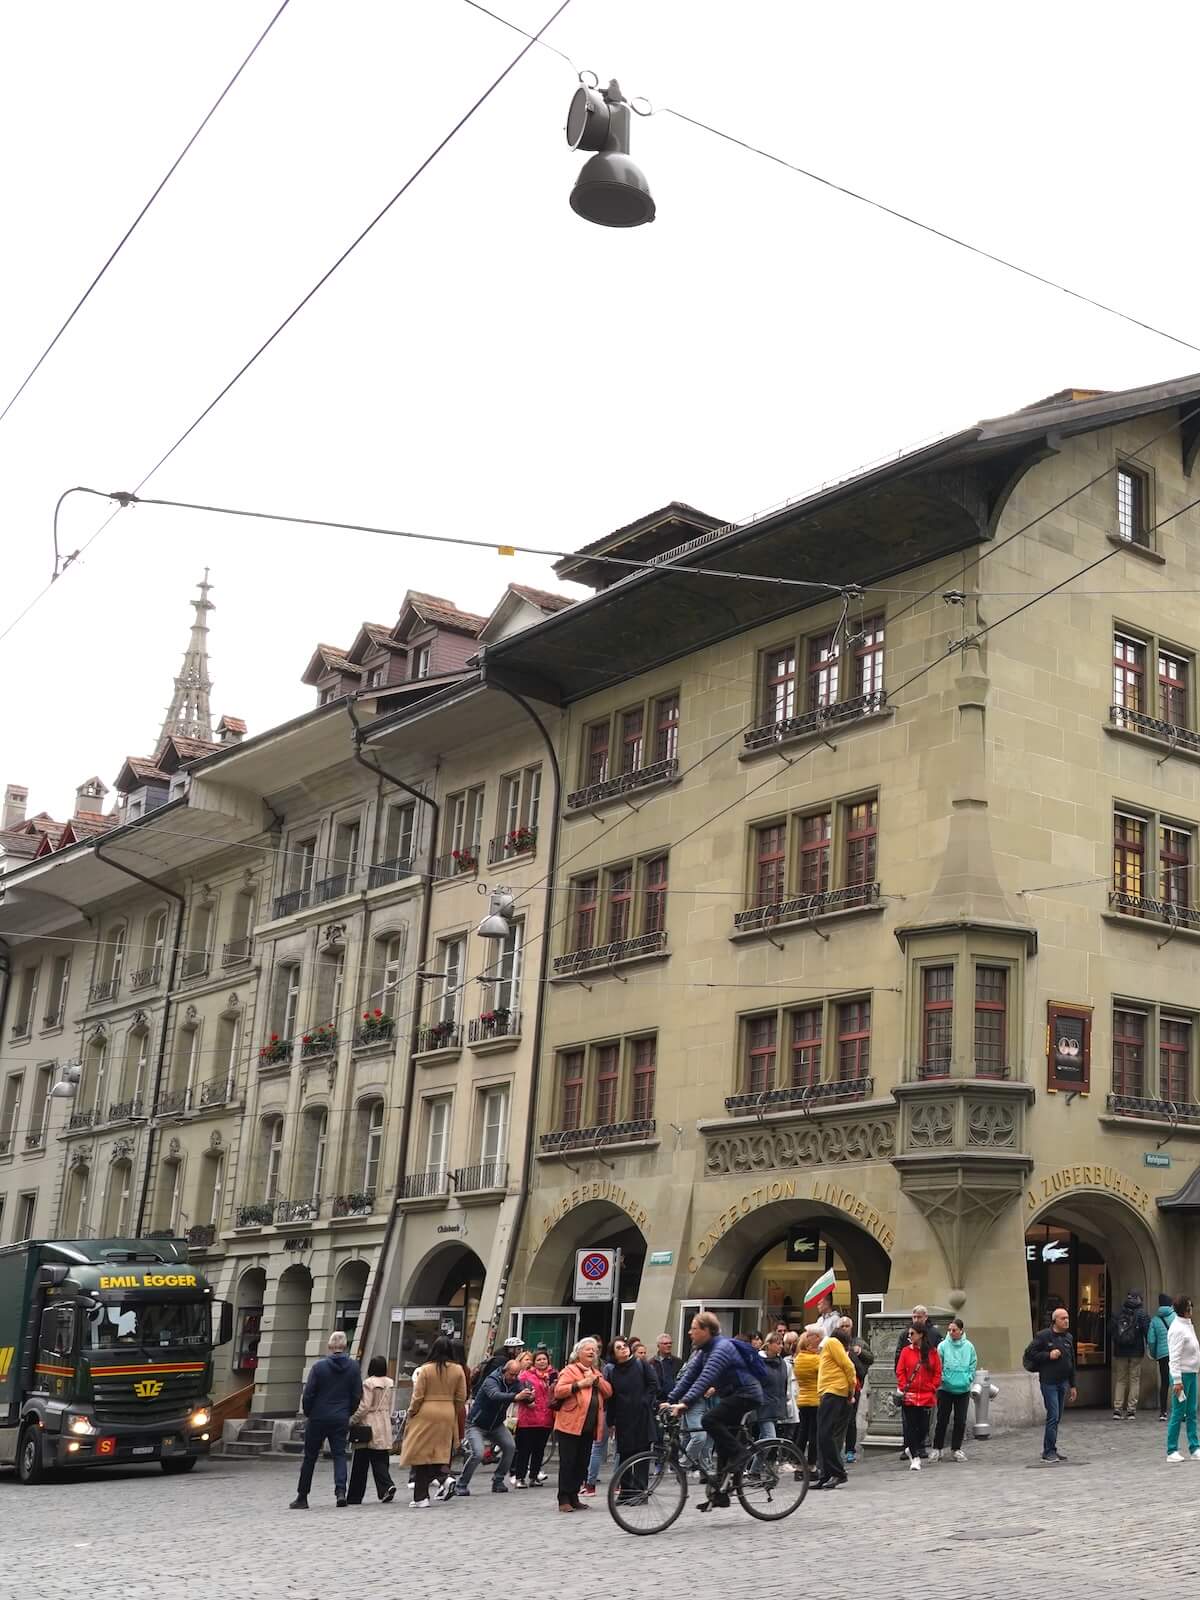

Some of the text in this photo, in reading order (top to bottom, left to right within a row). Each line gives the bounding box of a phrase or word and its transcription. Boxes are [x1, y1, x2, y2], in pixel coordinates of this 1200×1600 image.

[688, 1179, 896, 1274] CONFECTION LINGERIE
[100, 1275, 197, 1289] EMIL EGGER
